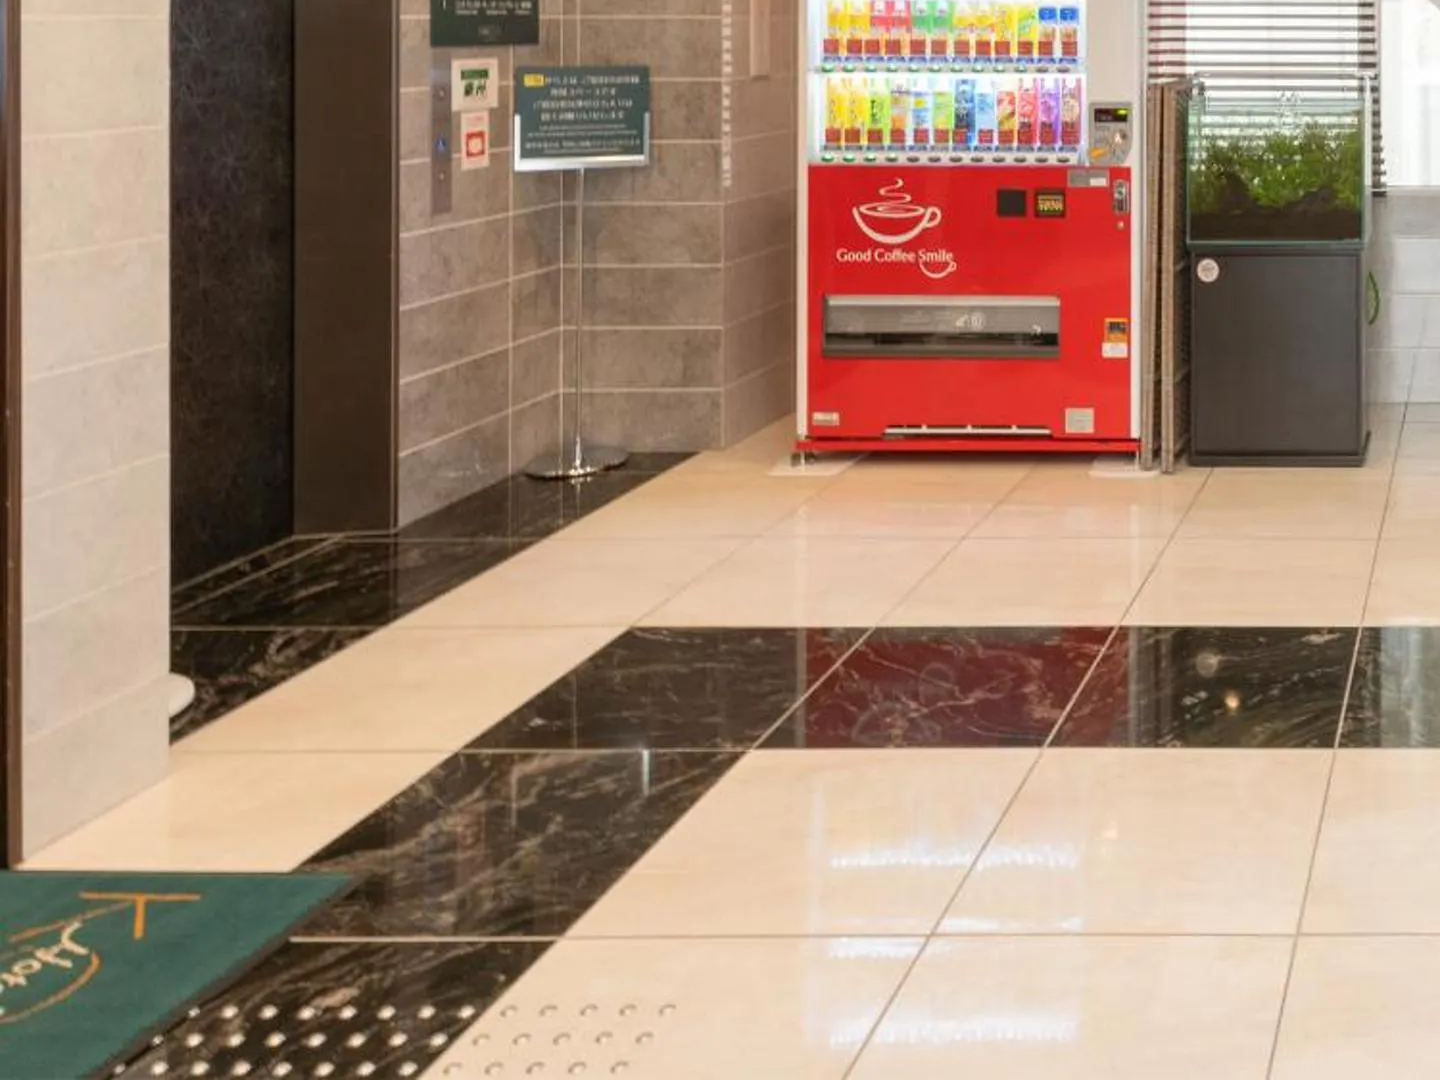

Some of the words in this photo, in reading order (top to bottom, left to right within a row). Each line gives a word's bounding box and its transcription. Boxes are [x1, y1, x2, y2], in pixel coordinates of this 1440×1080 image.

[836, 248, 872, 263] Good
[874, 248, 916, 263] Coffee
[918, 248, 953, 263] Smile
